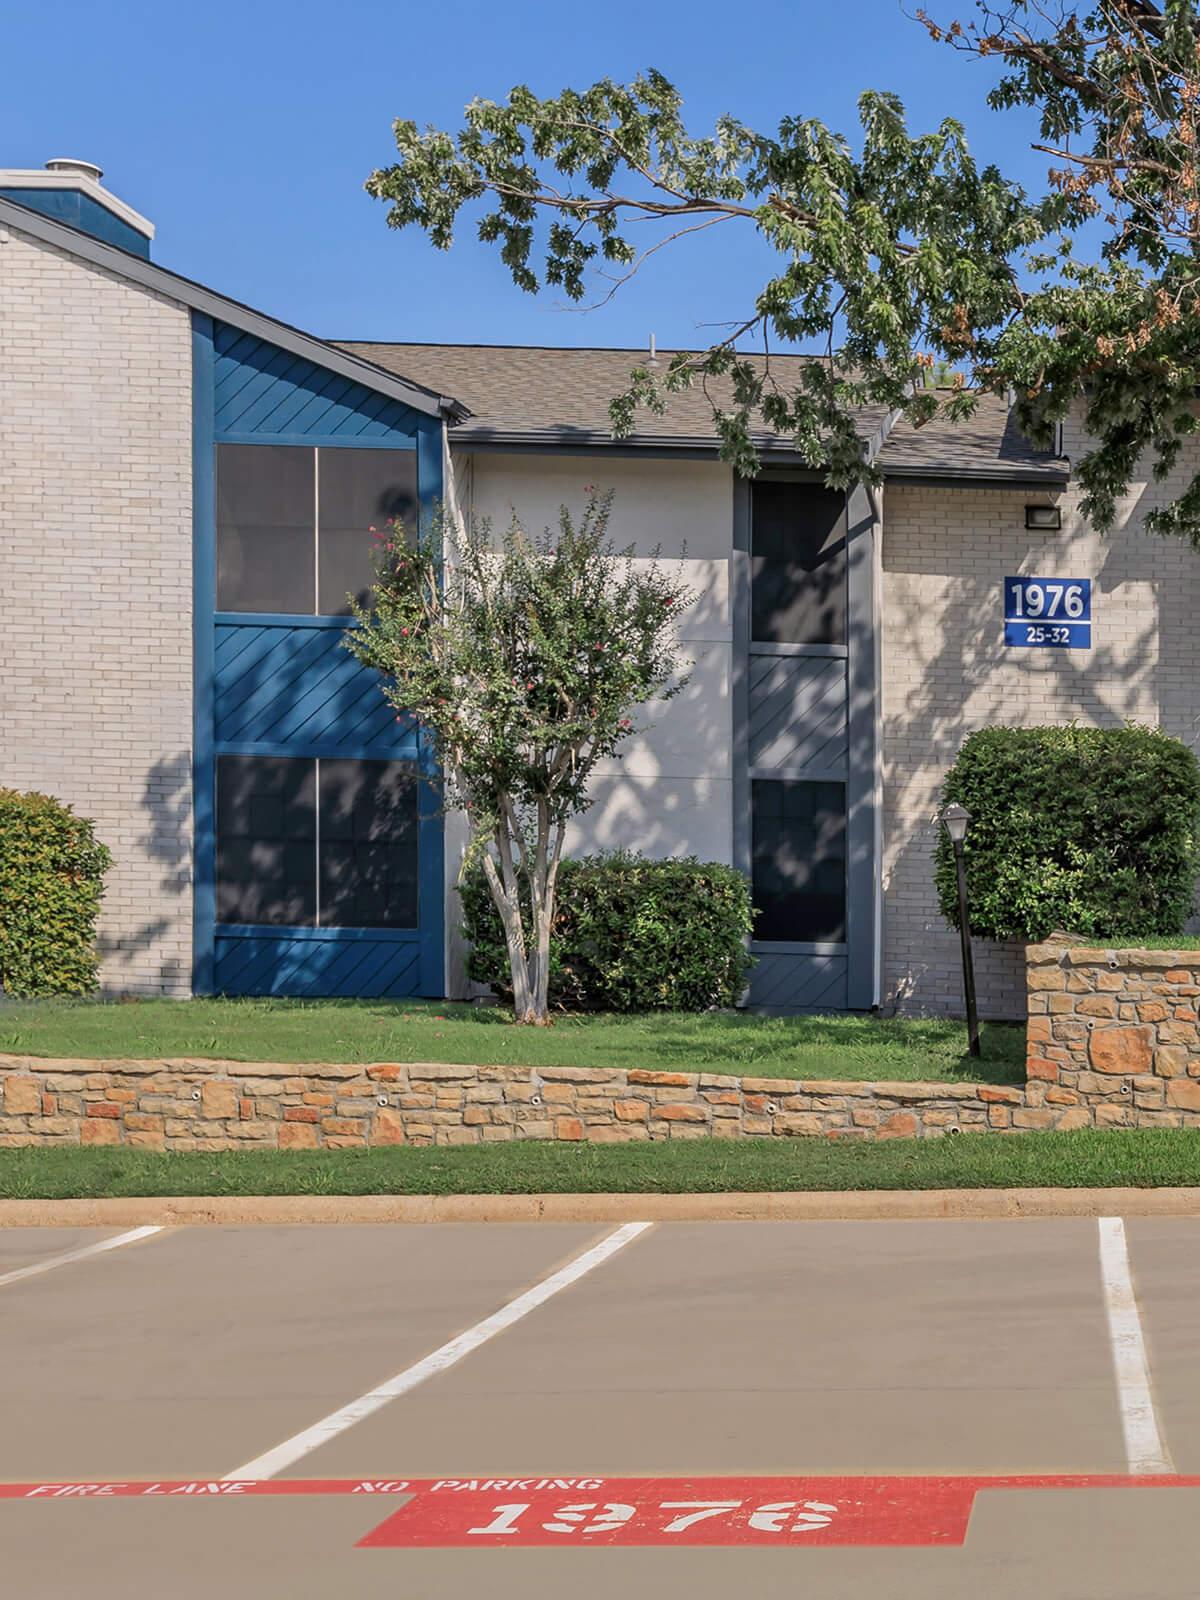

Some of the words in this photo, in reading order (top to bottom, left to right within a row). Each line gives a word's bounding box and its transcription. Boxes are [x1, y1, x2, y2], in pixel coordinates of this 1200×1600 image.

[1012, 584, 1084, 618] 1976
[1026, 626, 1070, 643] 25-32
[25, 1484, 127, 1497] FIRE
[141, 1482, 256, 1495] LANE
[352, 1481, 409, 1493] NO
[430, 1479, 604, 1492] PARKING
[466, 1501, 838, 1535] 1976
